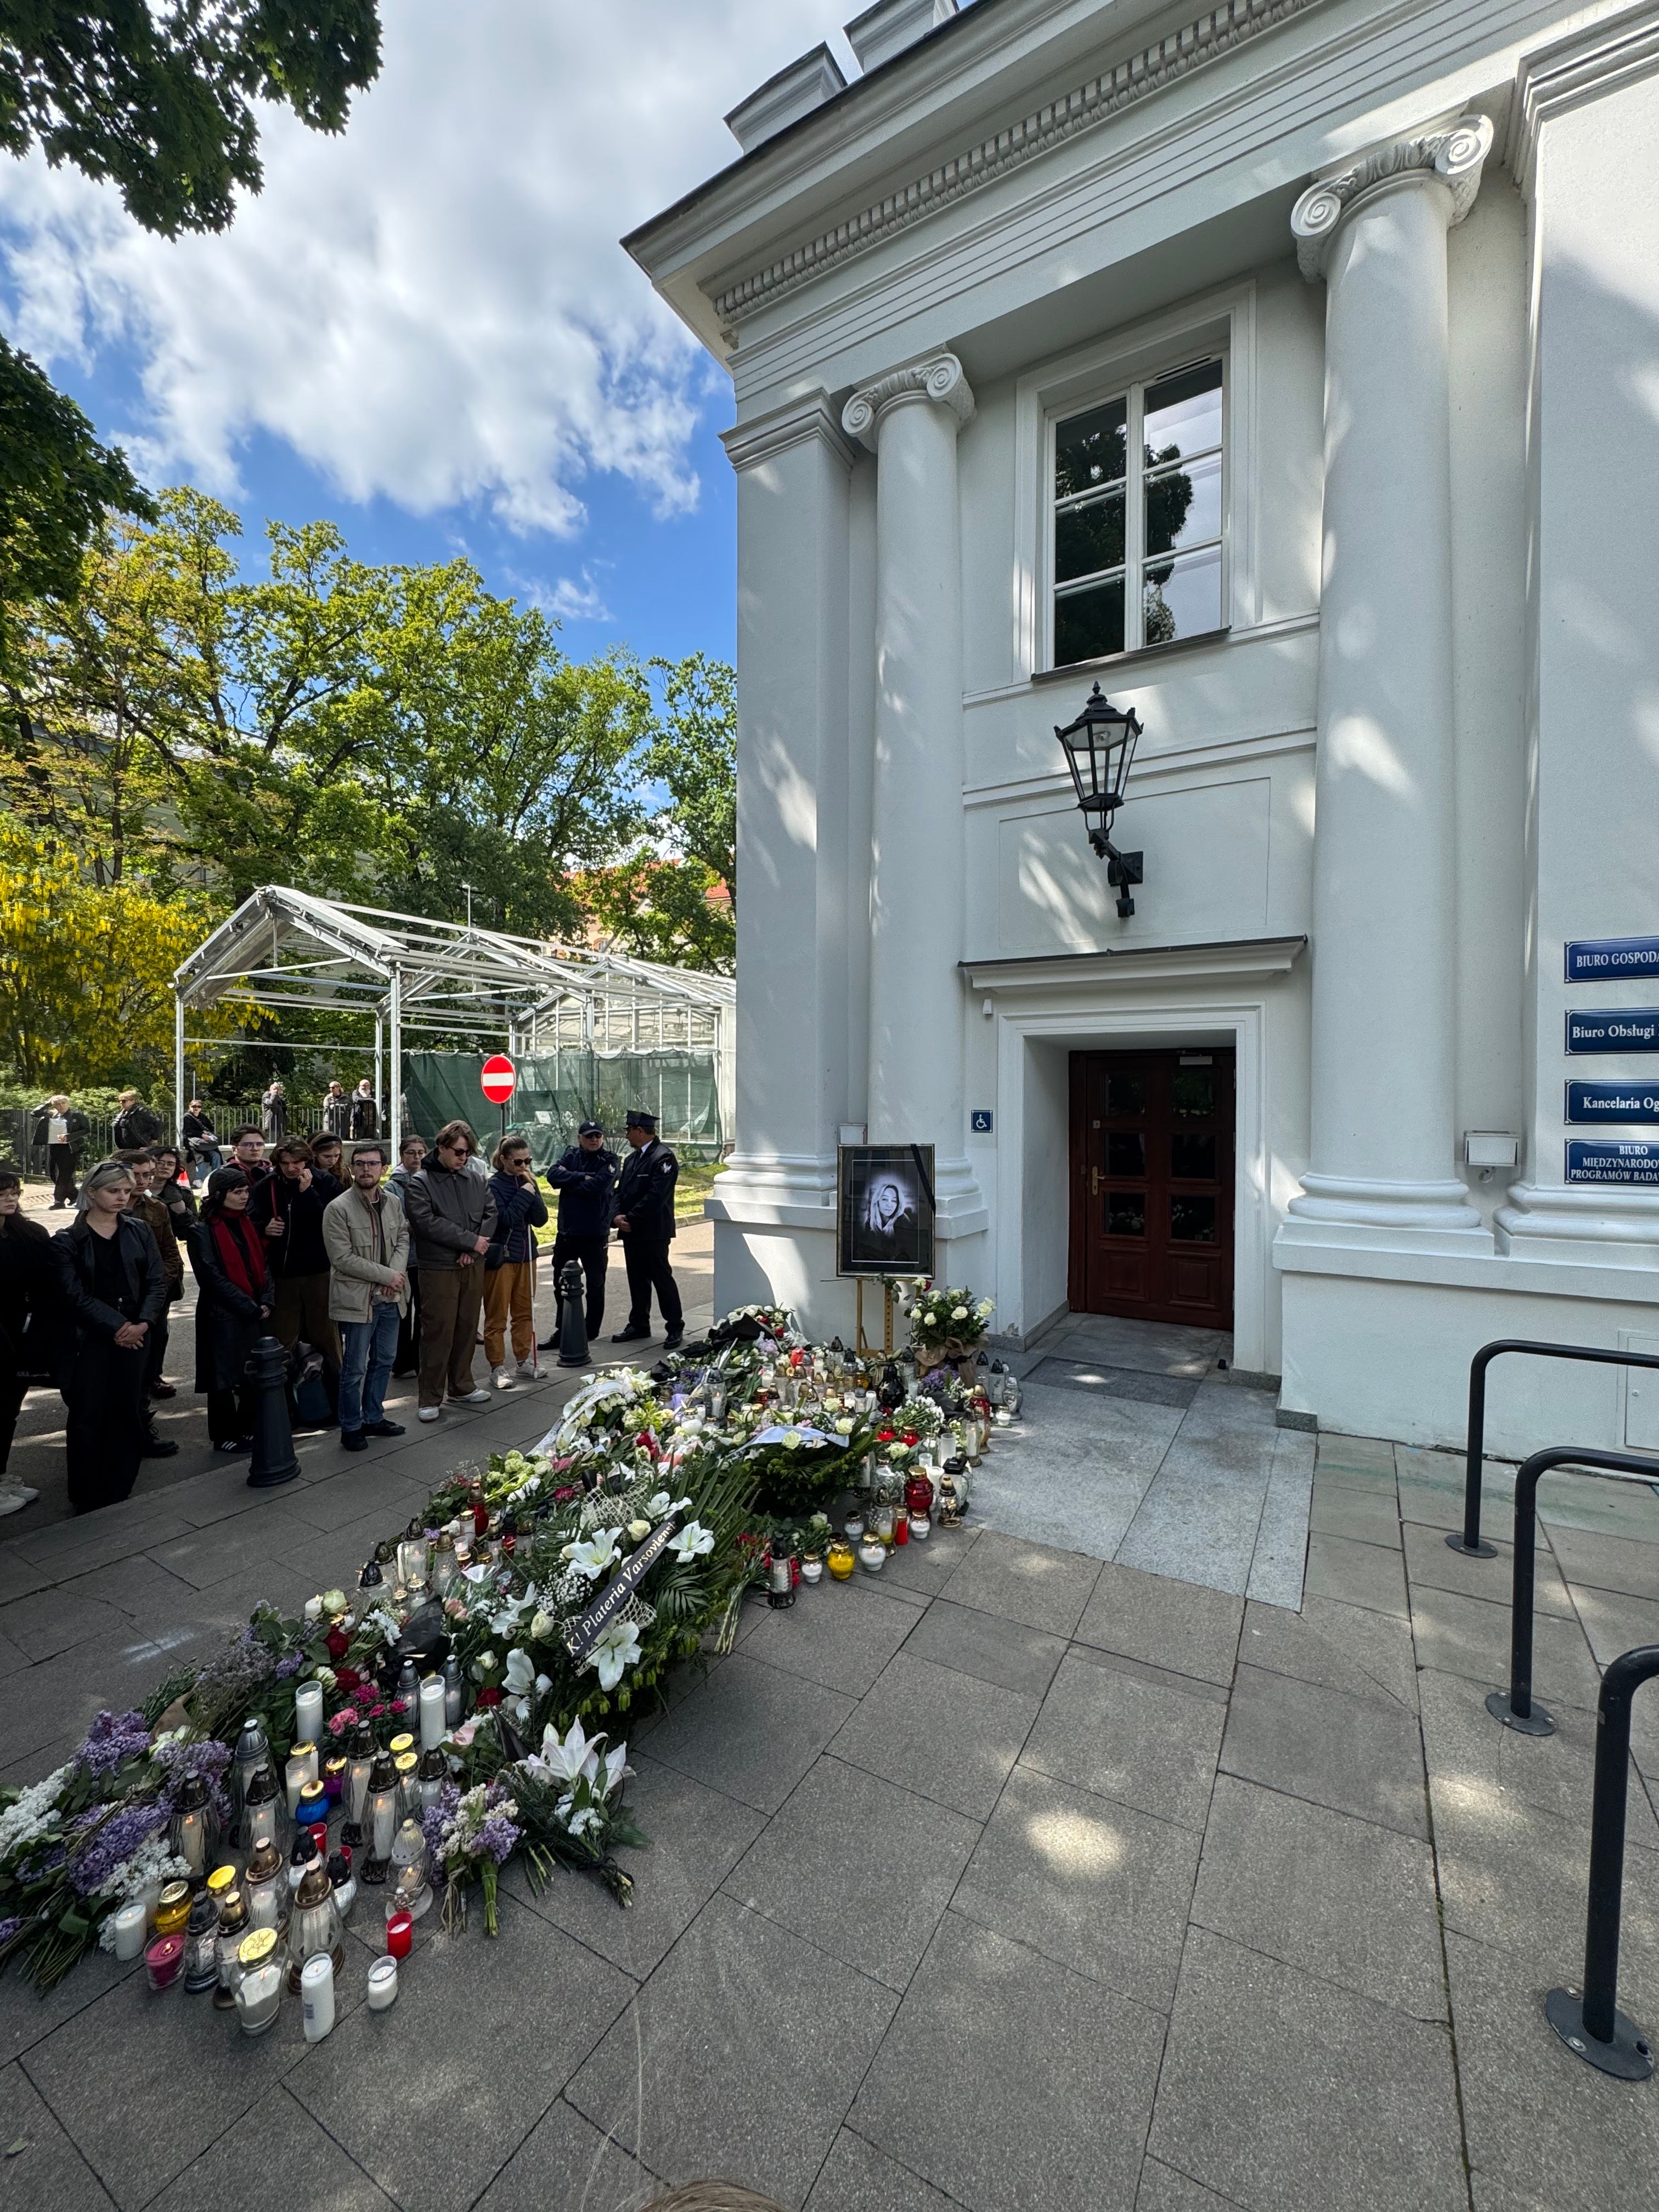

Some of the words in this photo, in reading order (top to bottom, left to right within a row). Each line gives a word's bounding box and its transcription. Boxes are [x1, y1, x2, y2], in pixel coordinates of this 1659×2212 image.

[1576, 954, 1609, 968] BIURO
[1611, 951, 1659, 965] GOSPOD
[1572, 1026, 1605, 1038] Biuro
[1608, 1024, 1655, 1039] Obsługi
[1583, 1096, 1640, 1109] Kancelaria
[1619, 1145, 1648, 1155] BIURO
[1582, 1157, 1659, 1169] MIĘDZYNARODO
[1571, 1169, 1632, 1180] PROGRAMÓW
[1633, 1171, 1659, 1181] BADA
[582, 1582, 626, 1637] Plateria
